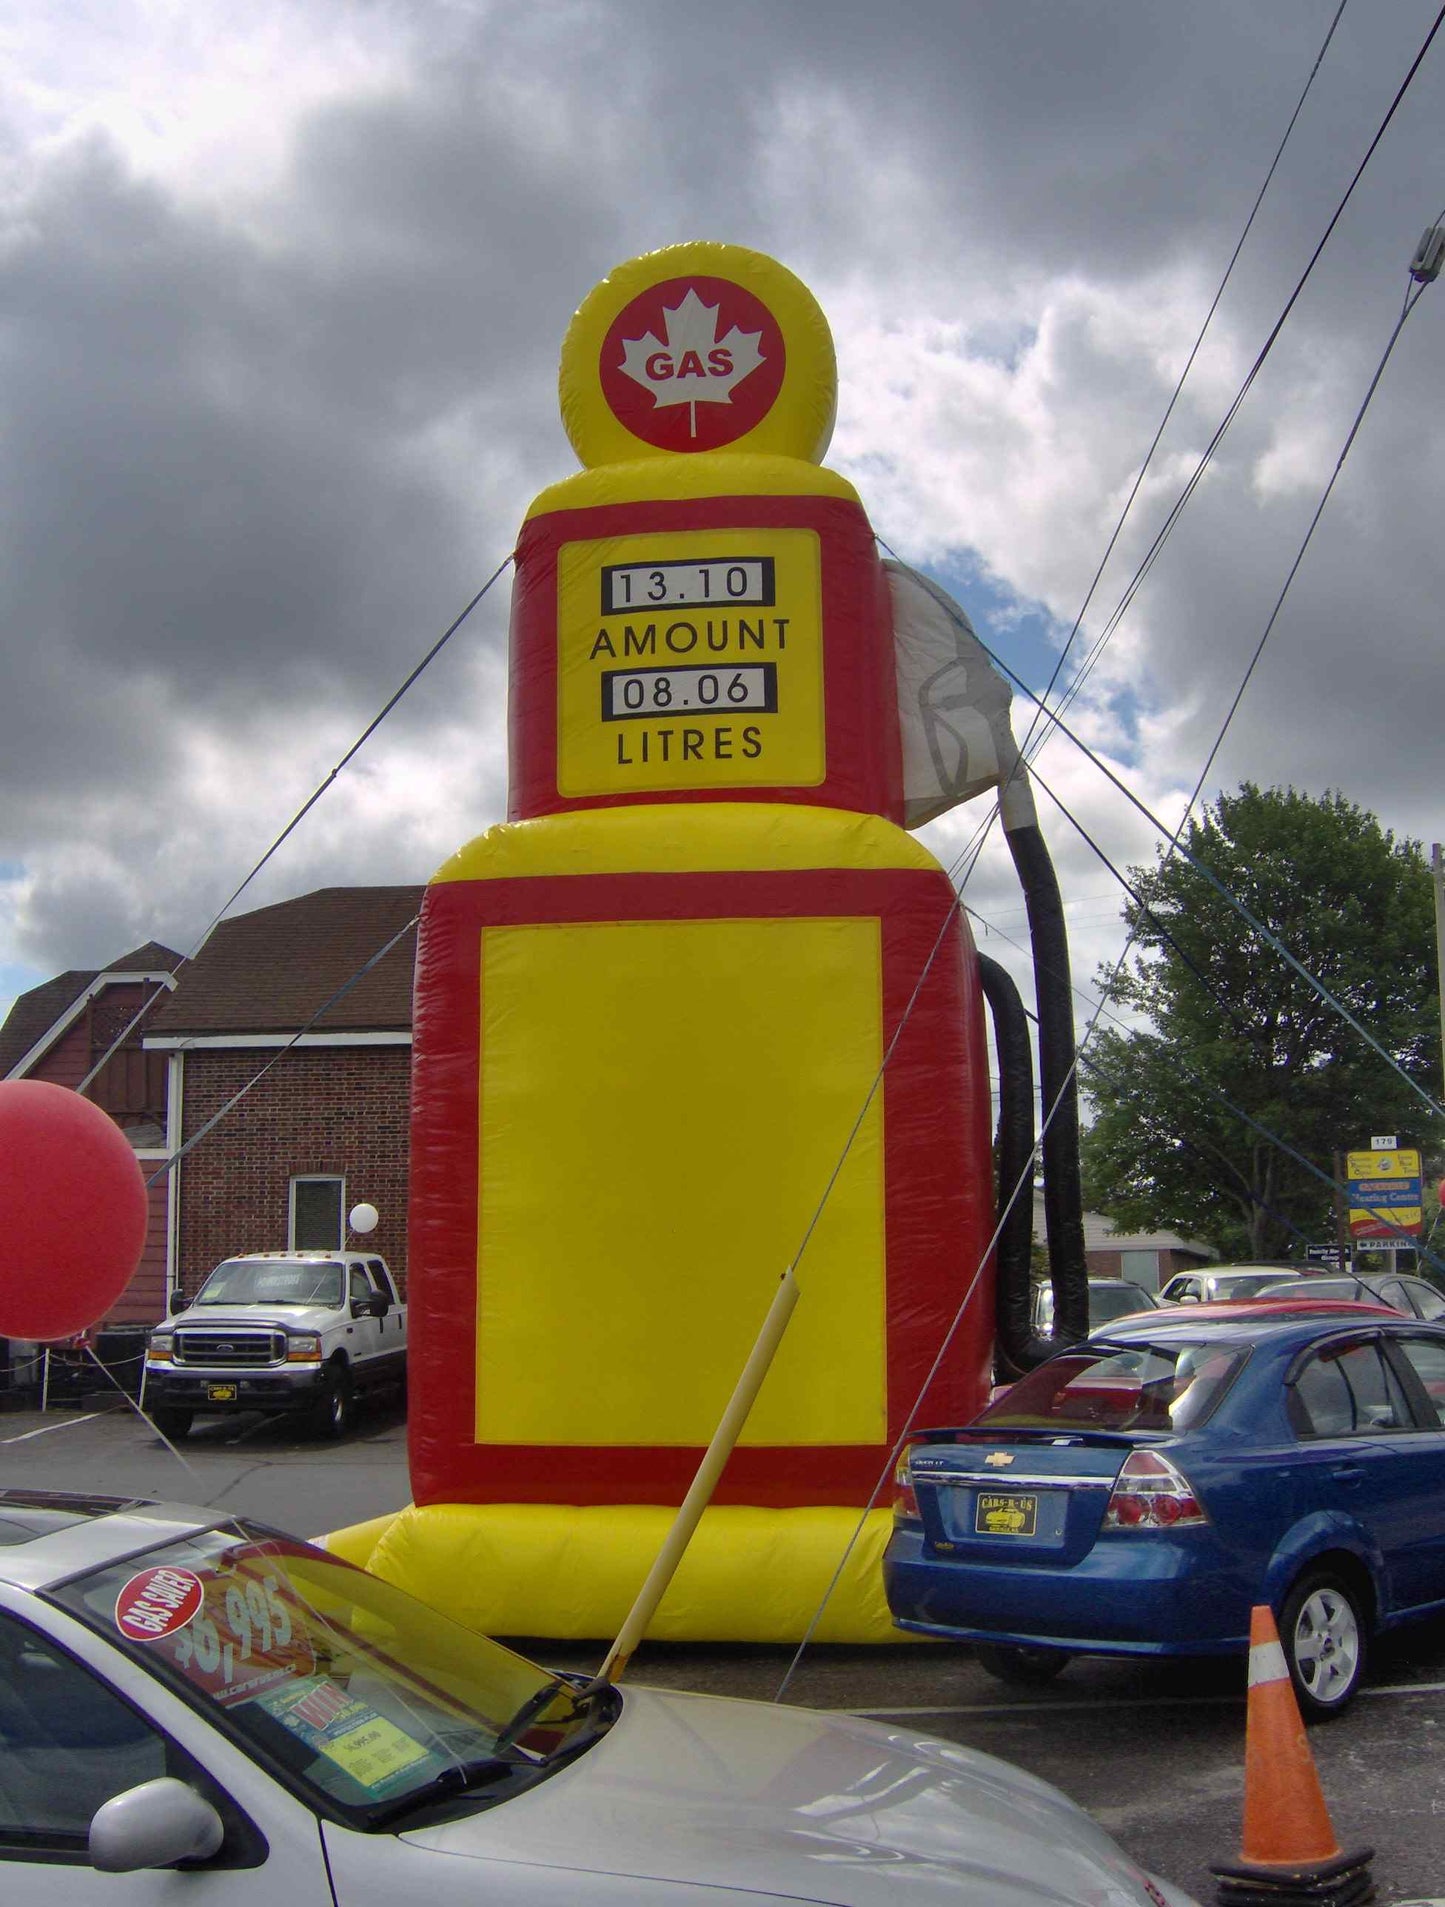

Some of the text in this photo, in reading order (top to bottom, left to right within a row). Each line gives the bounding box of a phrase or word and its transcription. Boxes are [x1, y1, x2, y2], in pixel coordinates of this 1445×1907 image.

[645, 348, 734, 381] GAS
[620, 566, 748, 603] 13.10
[589, 618, 790, 660] AMOUNT
[623, 672, 749, 709] 08.06
[617, 726, 762, 765] LITRES
[122, 1570, 197, 1632] GAS SAVER
[287, 1681, 354, 1732] WIN
